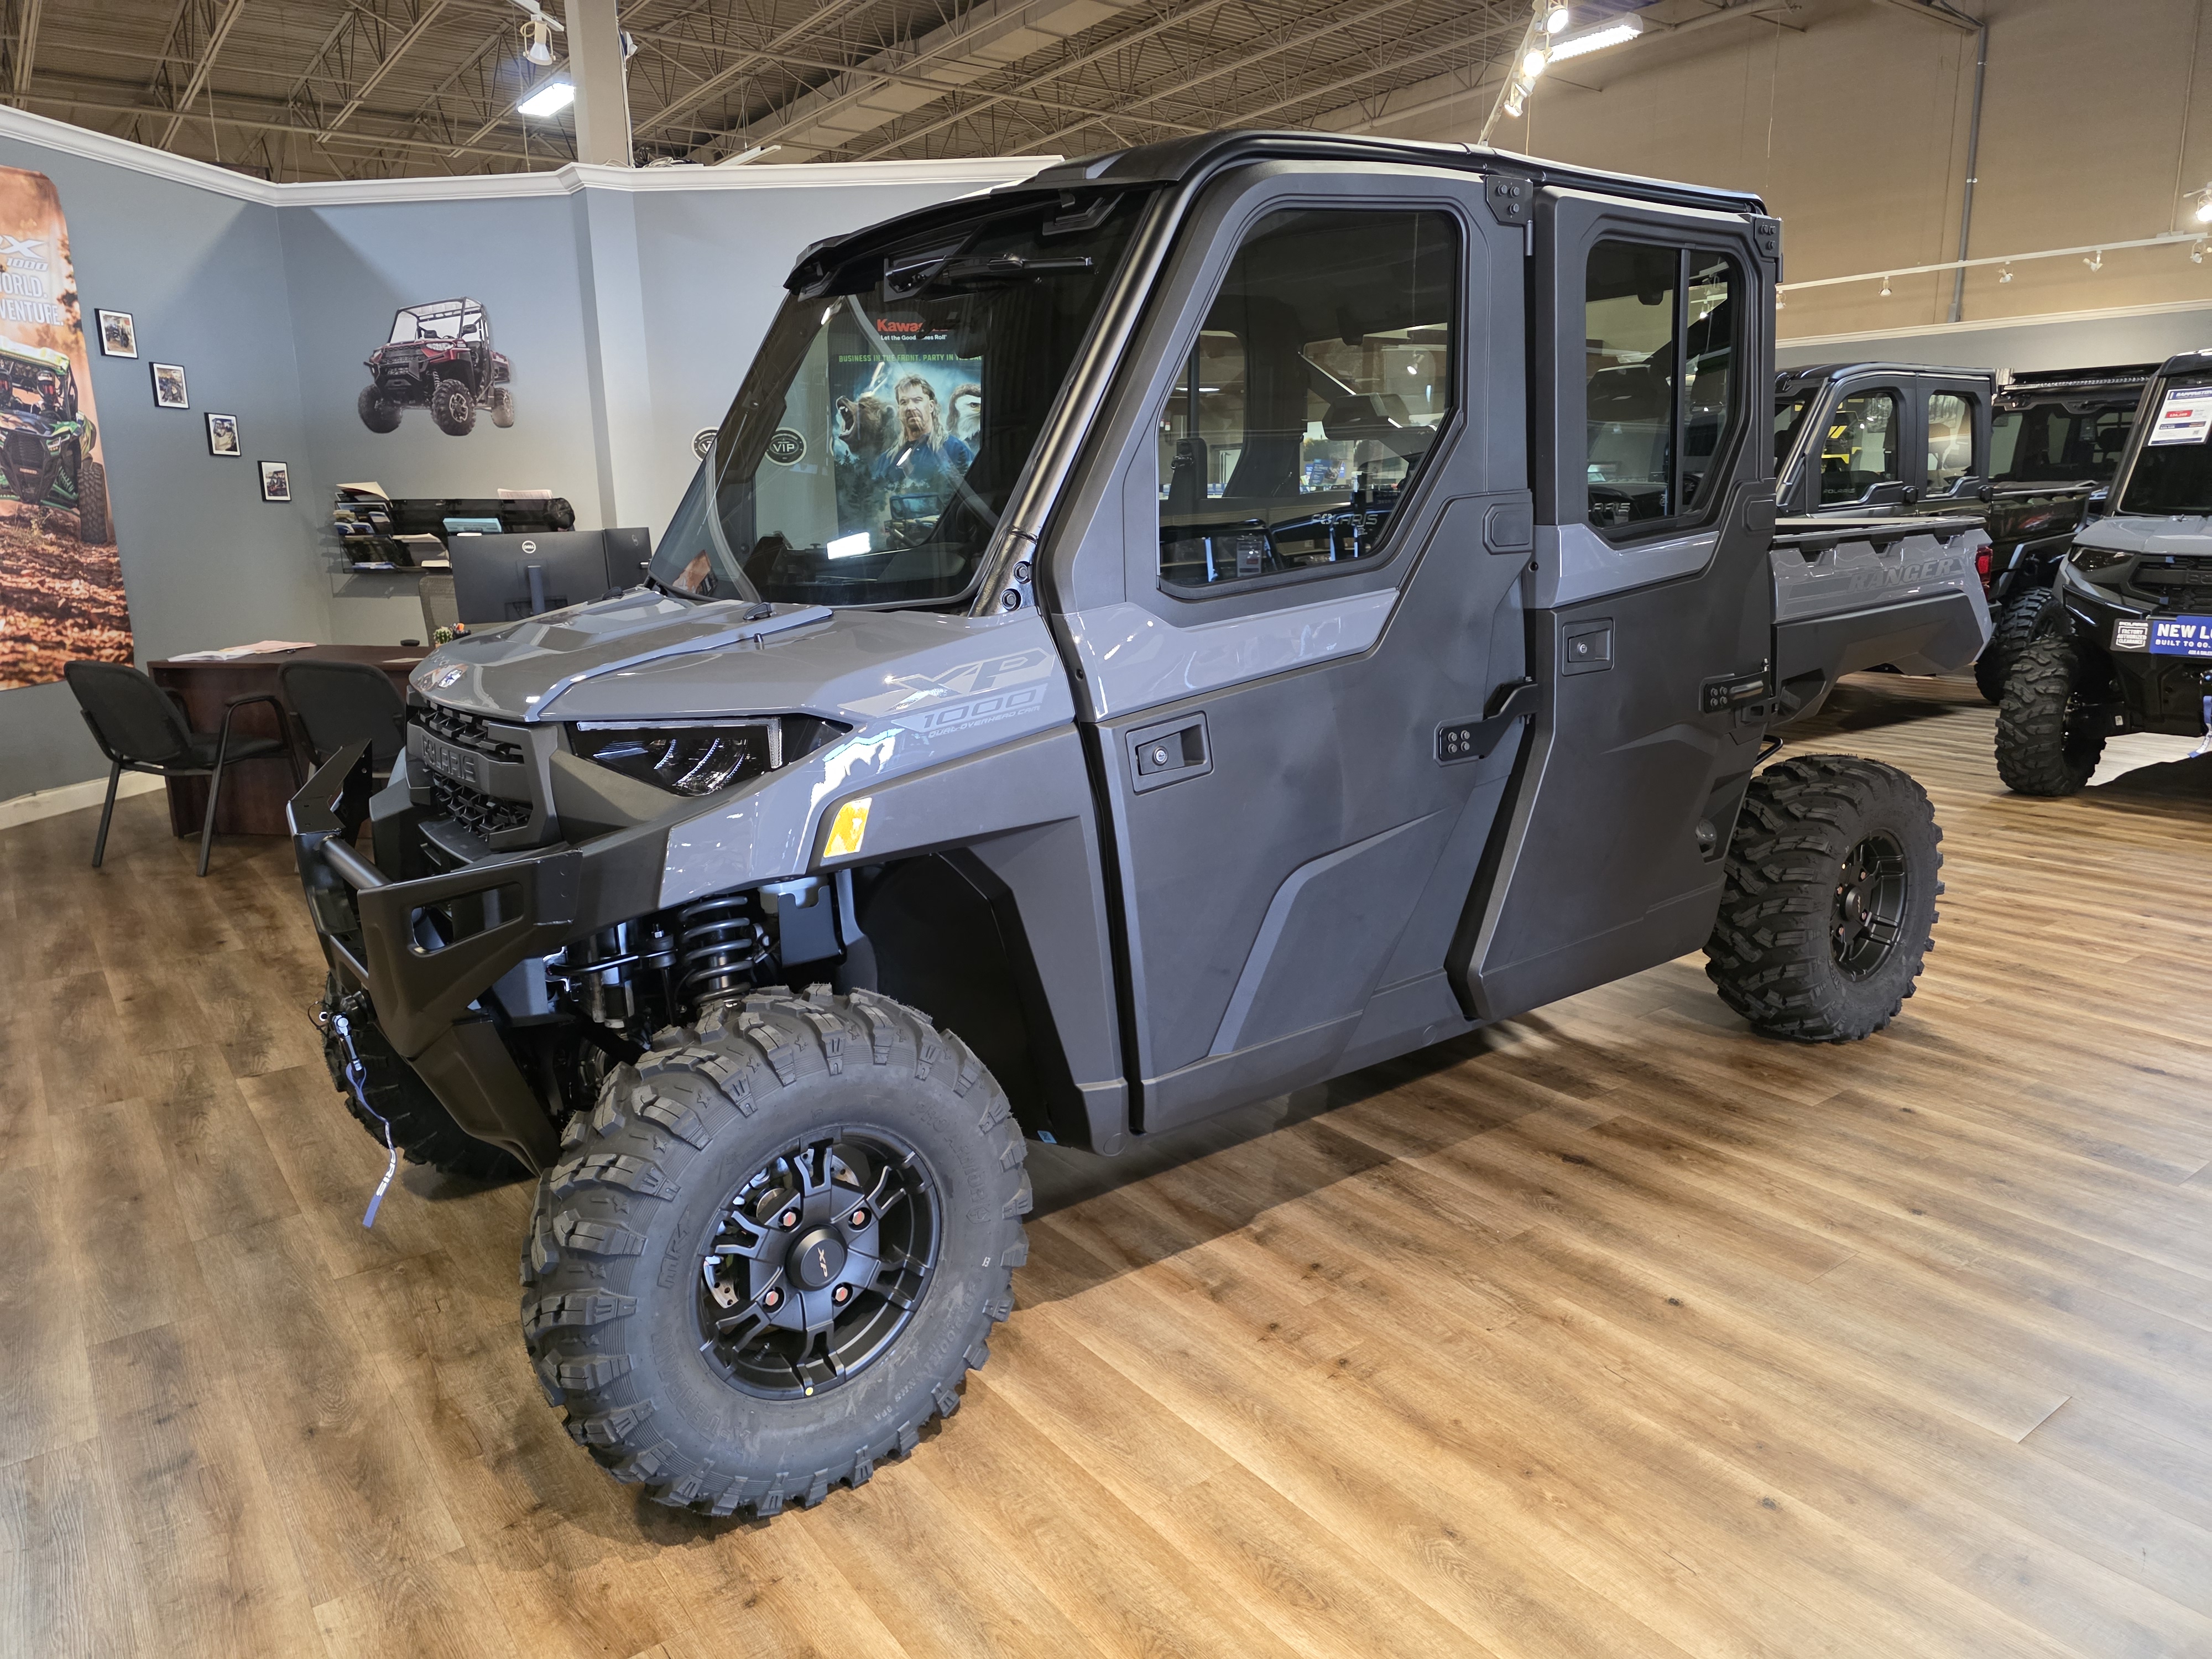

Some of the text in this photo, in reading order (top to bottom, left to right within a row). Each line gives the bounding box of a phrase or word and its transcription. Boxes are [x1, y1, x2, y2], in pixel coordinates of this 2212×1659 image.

[7, 257, 48, 272] 1000
[0, 273, 48, 298] ORLD.
[773, 444, 795, 452] VIP
[1312, 513, 1378, 525] POLARIS
[1848, 557, 1954, 593] RANGER
[2157, 623, 2197, 638] NEW
[883, 647, 1052, 714] XP
[924, 688, 1037, 729] 1000
[1017, 705, 1041, 715] CAM
[817, 1247, 828, 1277] XP
